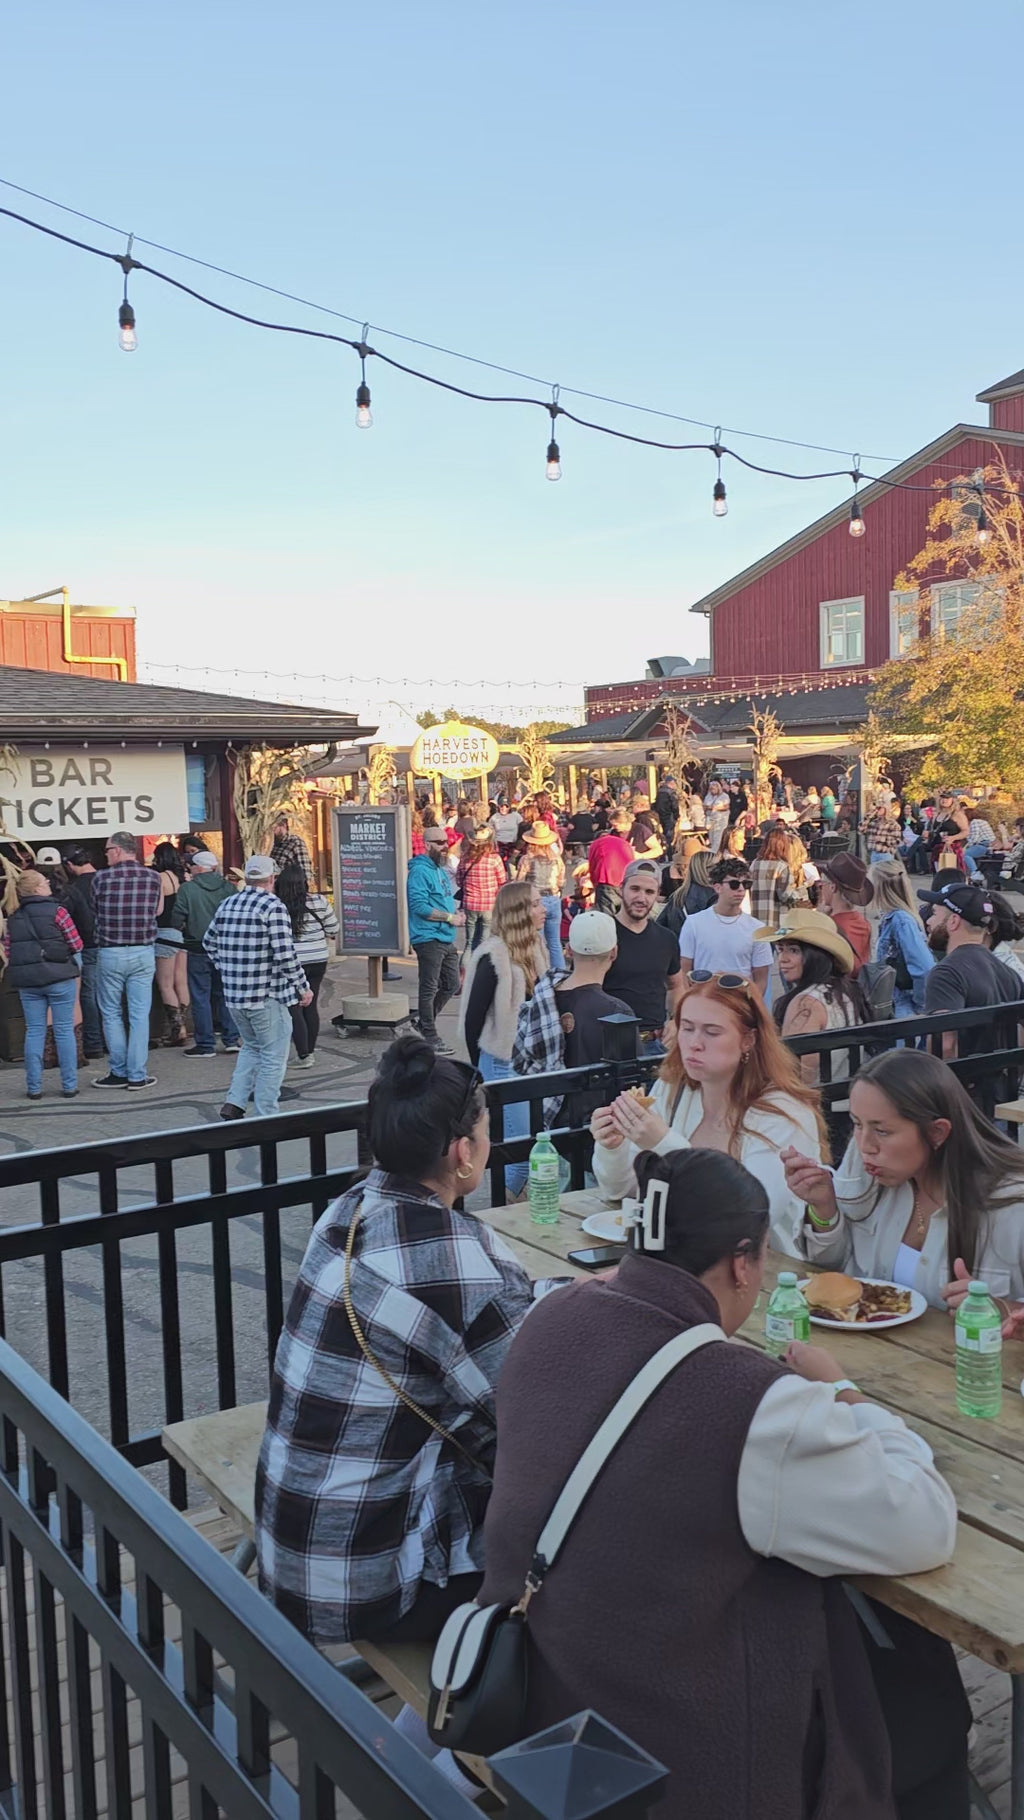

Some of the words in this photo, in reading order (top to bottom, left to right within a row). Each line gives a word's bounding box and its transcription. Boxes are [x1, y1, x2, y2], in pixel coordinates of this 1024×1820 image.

[423, 738, 488, 751] HARVEST
[423, 751, 489, 764] HOEDOWN
[30, 758, 114, 788] BAR
[350, 823, 386, 834] MARKET
